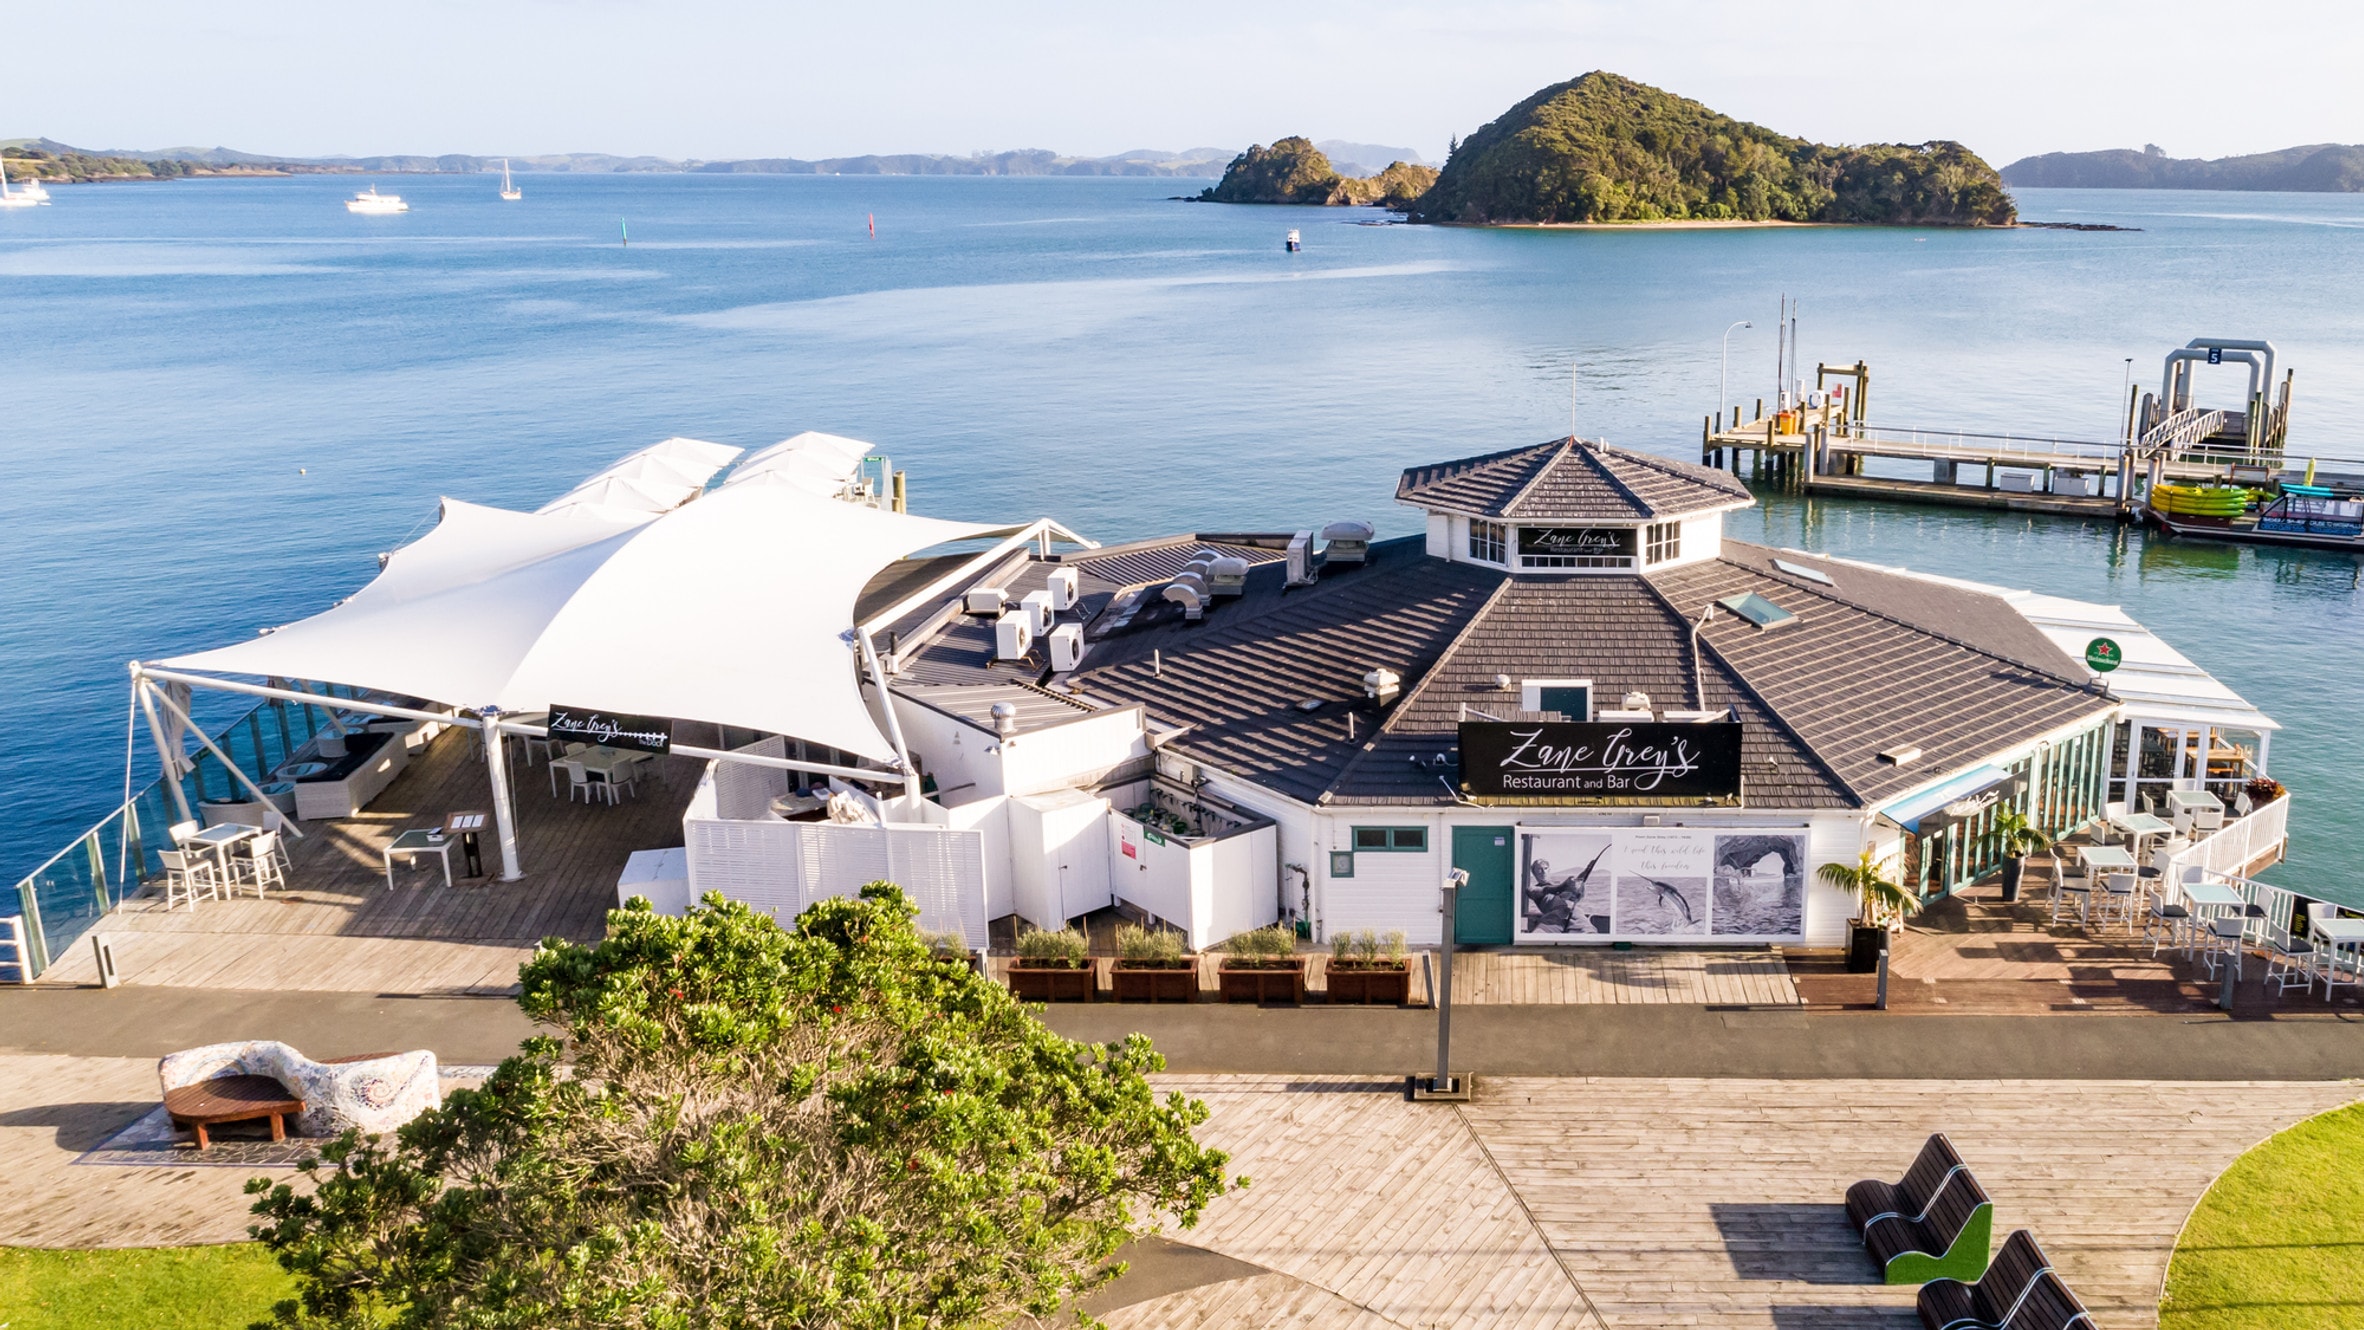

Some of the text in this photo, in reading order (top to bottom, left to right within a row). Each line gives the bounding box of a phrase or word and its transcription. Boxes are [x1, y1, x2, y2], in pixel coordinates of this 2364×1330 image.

[2210, 353, 2218, 363] 5
[1534, 528, 1622, 550] Zane Grey's
[551, 711, 622, 743] Zane Grey's
[1500, 727, 1700, 791] Zane Grey's
[1503, 774, 1630, 789] Restaurant and Bar
